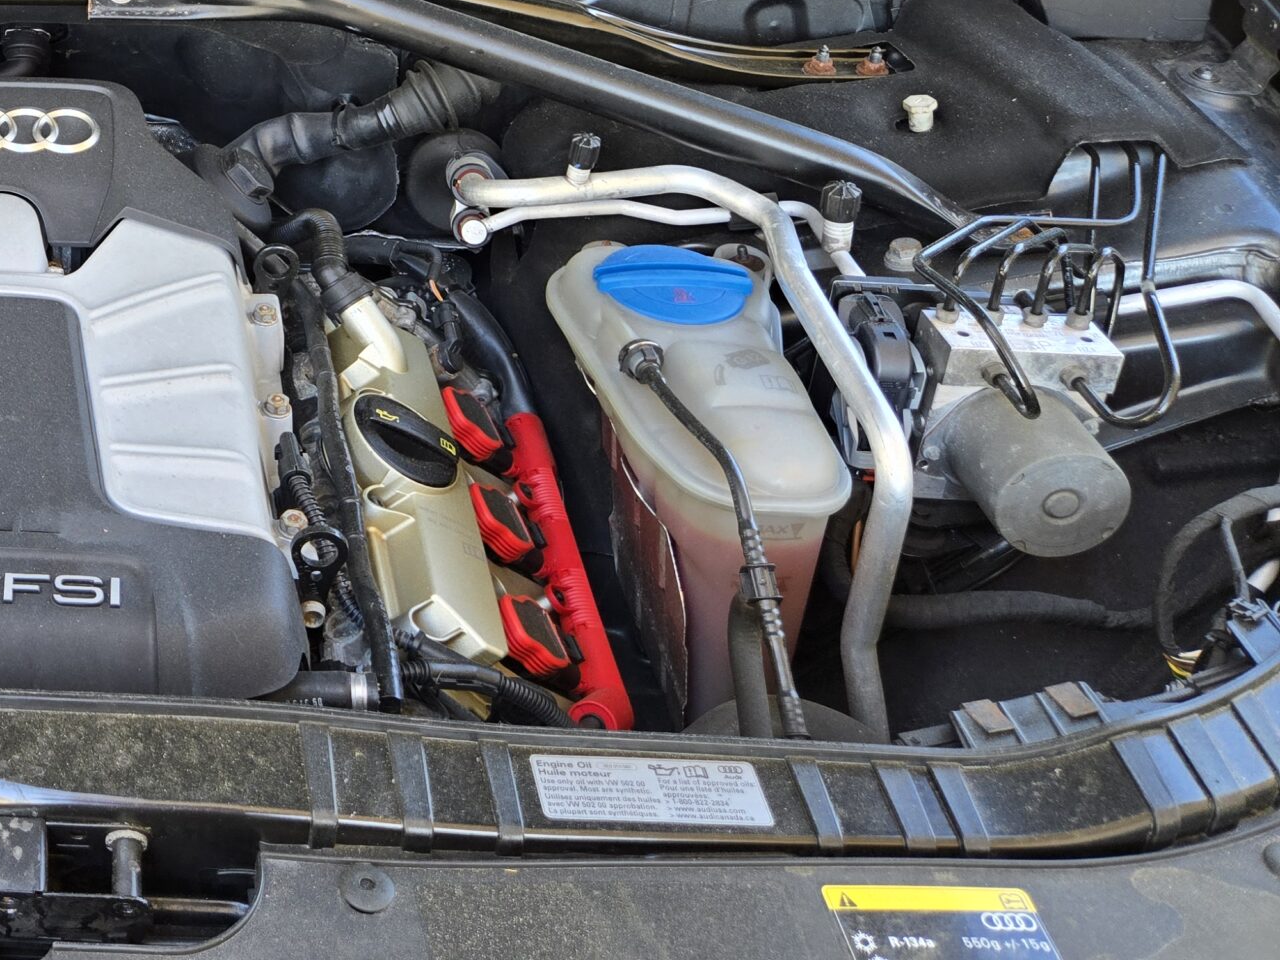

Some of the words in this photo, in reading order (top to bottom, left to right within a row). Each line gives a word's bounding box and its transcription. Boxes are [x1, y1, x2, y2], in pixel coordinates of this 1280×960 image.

[535, 759, 574, 769] Engine
[576, 761, 592, 769] Oil
[538, 767, 567, 776] Huile
[540, 776, 556, 784] Use
[557, 778, 574, 786] only
[587, 778, 604, 786] with
[702, 780, 739, 788] approved
[566, 800, 580, 808] VW
[559, 808, 588, 816] plupart
[888, 936, 936, 950] R-134a
